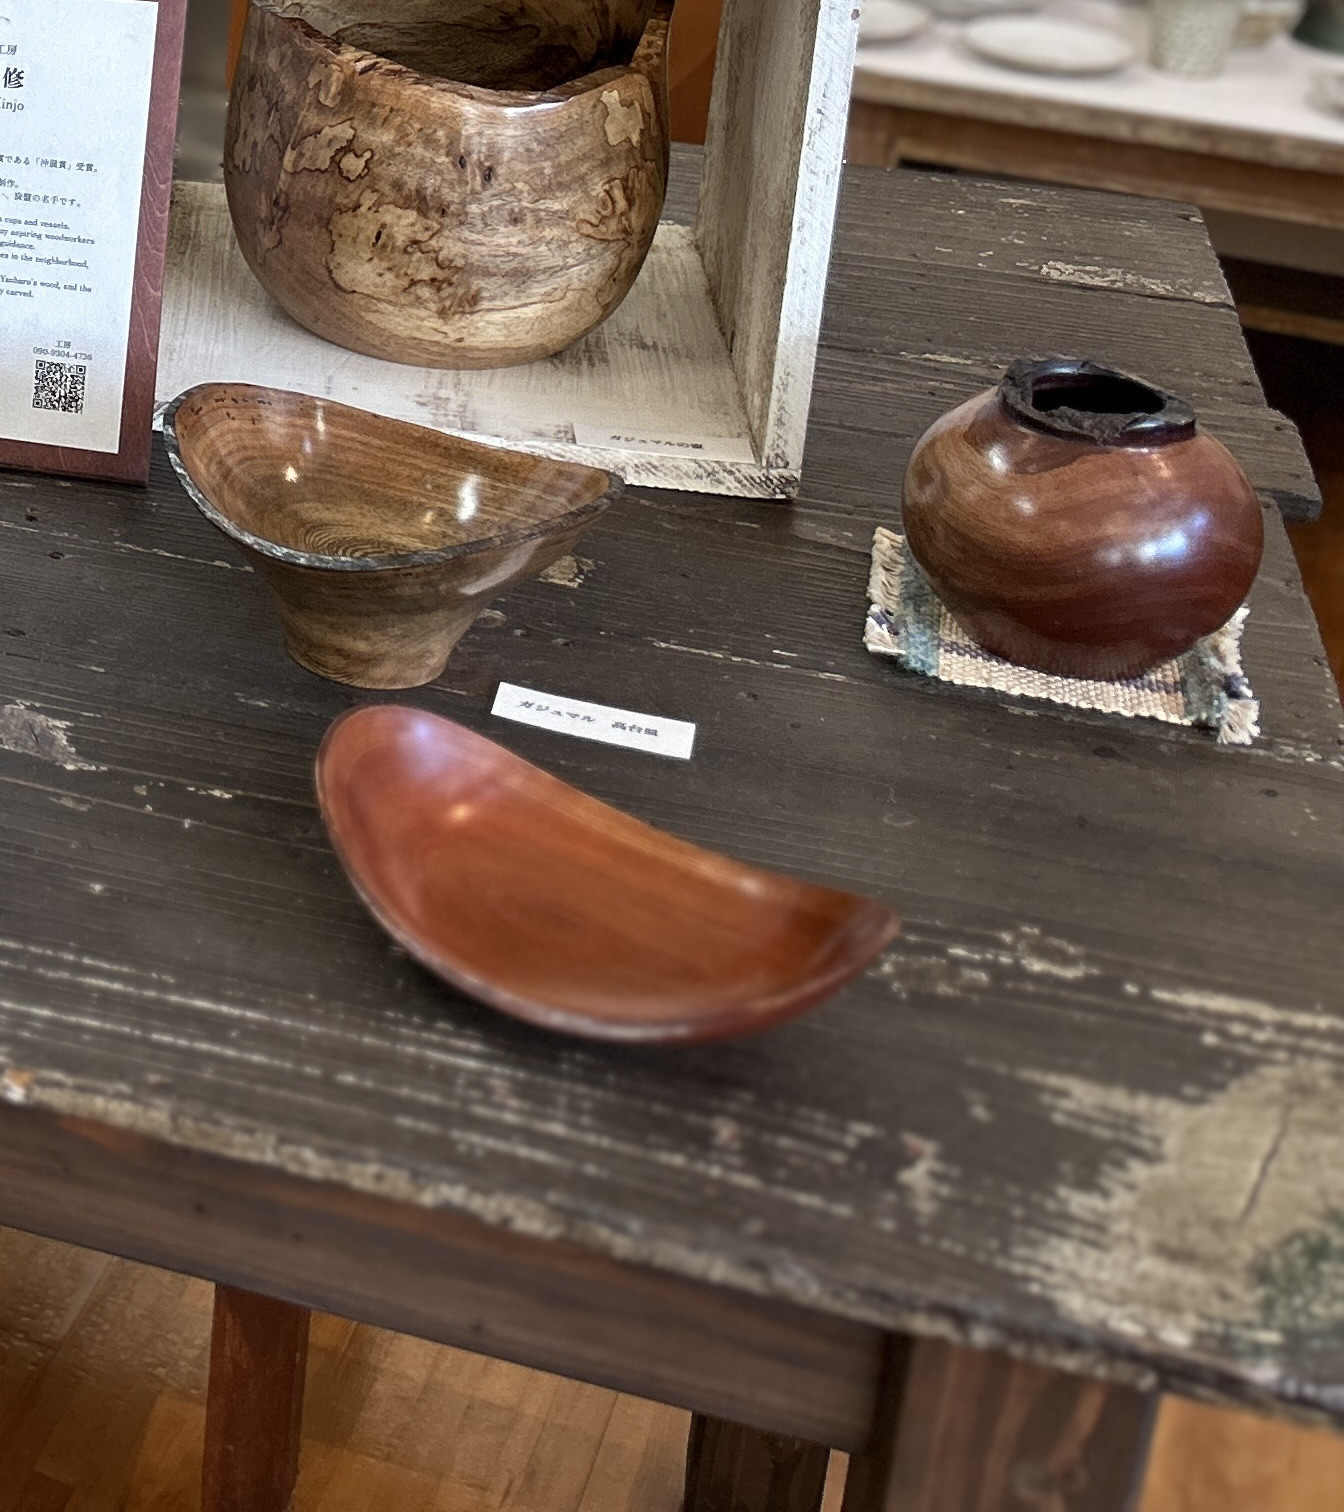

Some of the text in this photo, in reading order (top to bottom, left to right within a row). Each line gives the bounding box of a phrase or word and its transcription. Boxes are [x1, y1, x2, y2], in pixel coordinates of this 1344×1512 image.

[2, 67, 24, 89] 修
[10, 231, 42, 240] aspiring
[45, 234, 95, 244] woodworkers
[0, 240, 35, 250] guidance.
[11, 252, 19, 260] in
[21, 253, 33, 261] the
